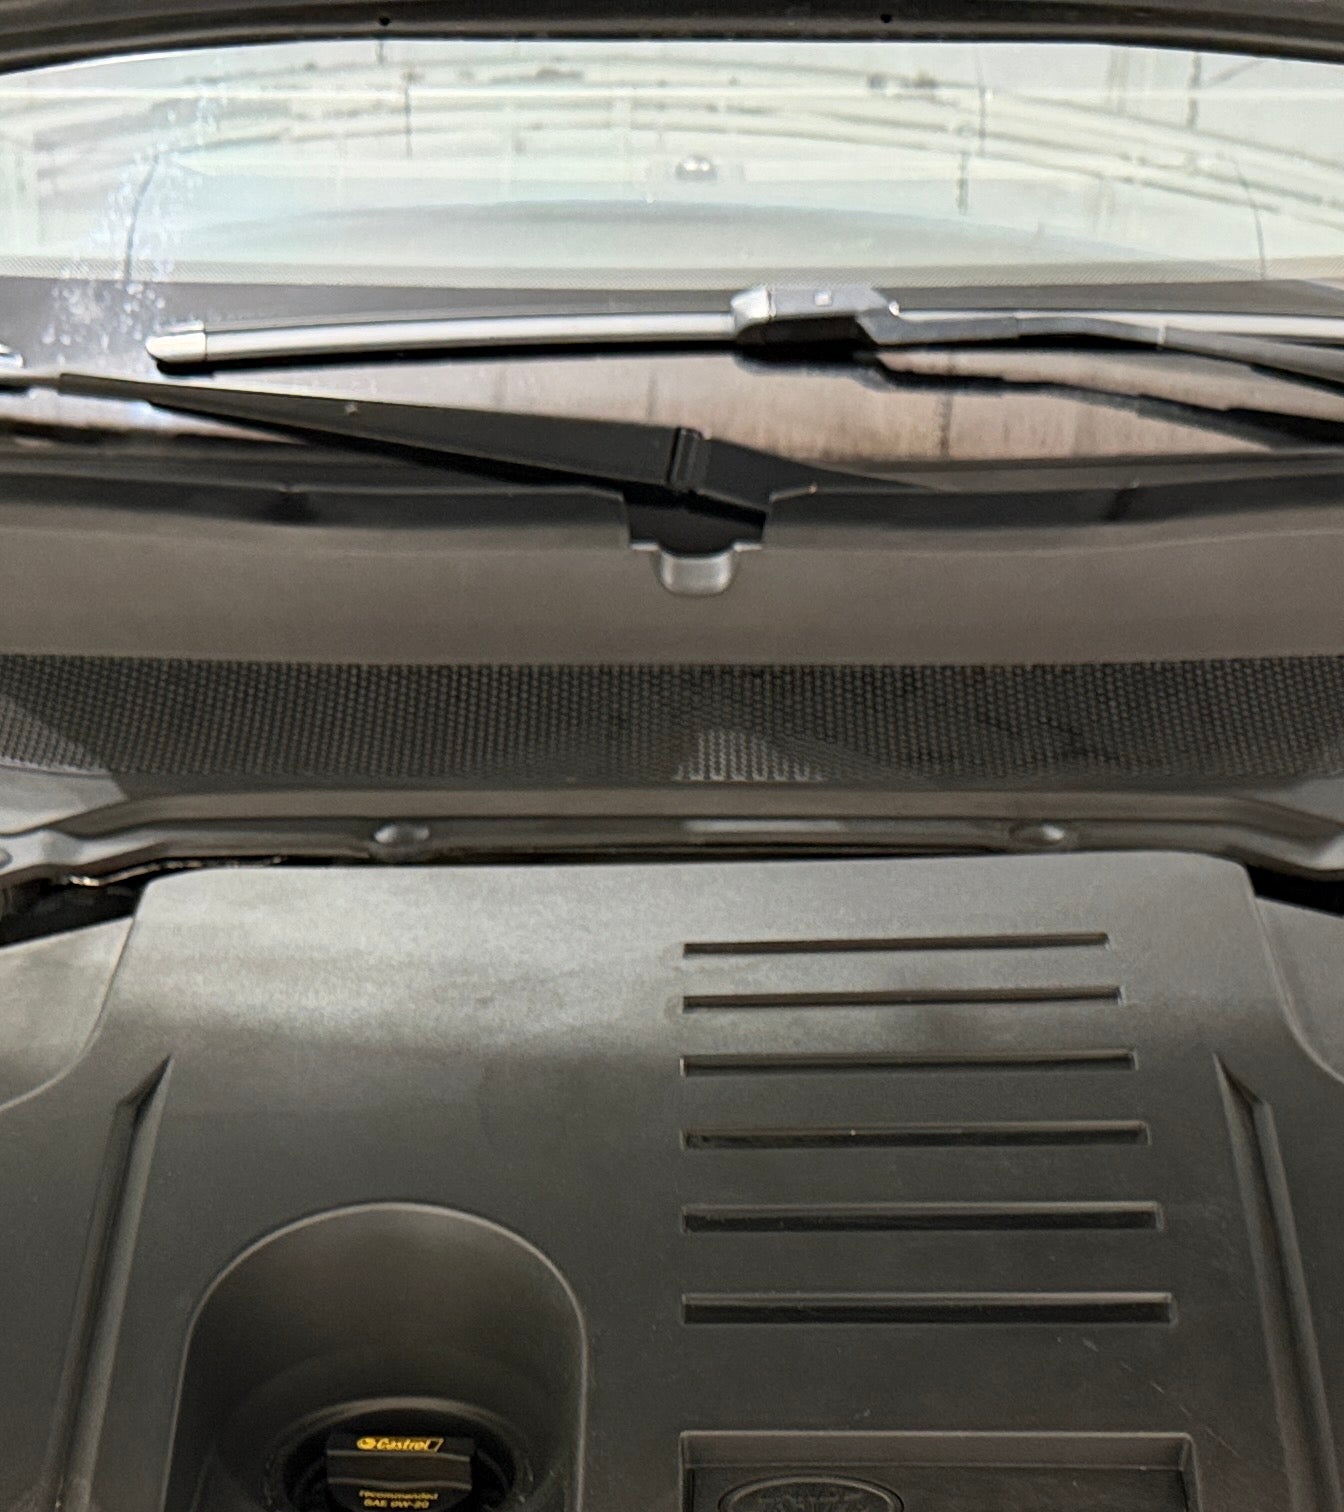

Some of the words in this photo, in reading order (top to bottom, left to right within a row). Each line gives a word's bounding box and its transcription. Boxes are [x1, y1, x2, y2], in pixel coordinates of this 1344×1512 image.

[376, 1438, 430, 1451] Castrol
[364, 1499, 387, 1507] SAE
[390, 1500, 430, 1508] 0W-20
